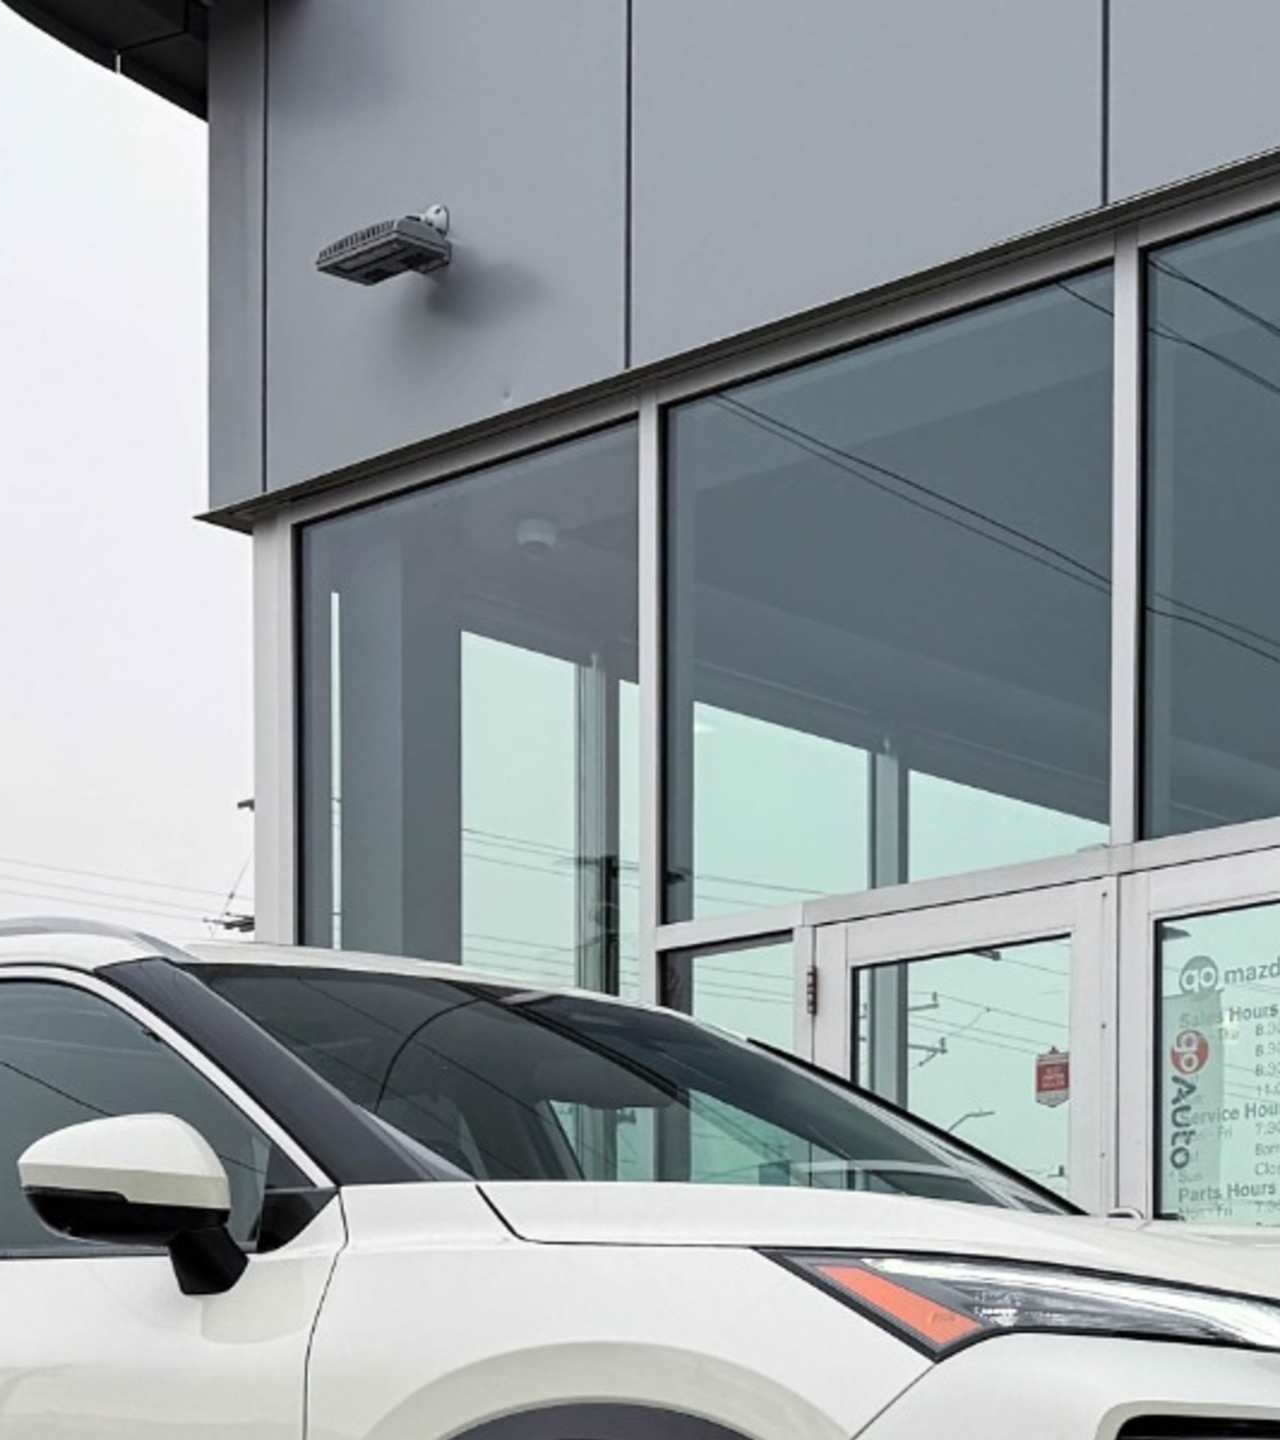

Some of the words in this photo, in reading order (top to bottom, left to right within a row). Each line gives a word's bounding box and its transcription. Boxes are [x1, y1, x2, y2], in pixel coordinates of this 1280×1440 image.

[1179, 1007, 1224, 1028] Sals
[1228, 1004, 1280, 1022] Hours
[1170, 1075, 1197, 1169] Auto
[1179, 1185, 1222, 1203] Parts
[1227, 1182, 1277, 1199] Hours
